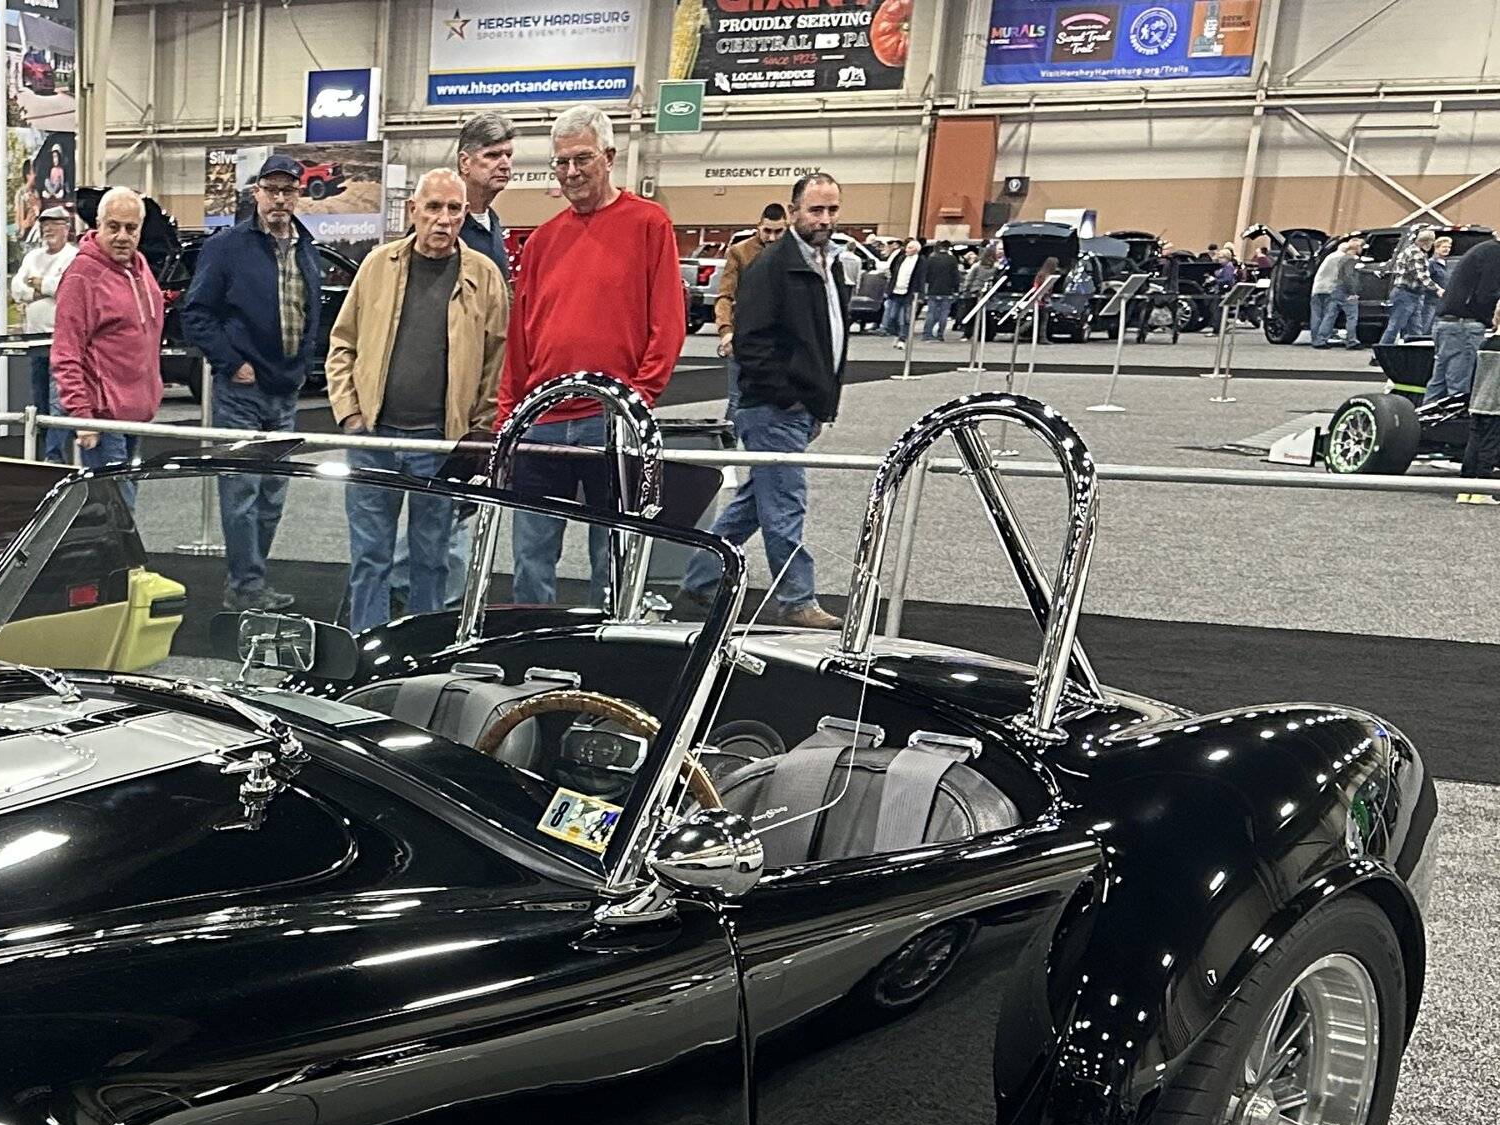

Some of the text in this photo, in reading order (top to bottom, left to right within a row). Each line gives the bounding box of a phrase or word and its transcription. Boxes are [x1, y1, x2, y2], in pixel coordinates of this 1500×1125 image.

[478, 11, 630, 29] HERSHEY HARRISBURG
[718, 12, 872, 32] PROUDLY SERVING
[477, 30, 514, 40] SPORTS
[528, 28, 566, 38] EVENTS
[571, 25, 629, 36] AUTHORITY
[991, 24, 1046, 39] MURALS
[716, 32, 870, 54] CENTRAL PA
[731, 70, 816, 82] LOCAL PRODUCE
[436, 78, 627, 97] www.hhsportsandevents.com
[311, 88, 365, 118] Ford
[209, 151, 238, 165] Silve
[527, 171, 548, 181] EXIT
[705, 168, 766, 178] EMERGENCY
[768, 168, 792, 177] EXIT
[319, 221, 376, 235] Colorado
